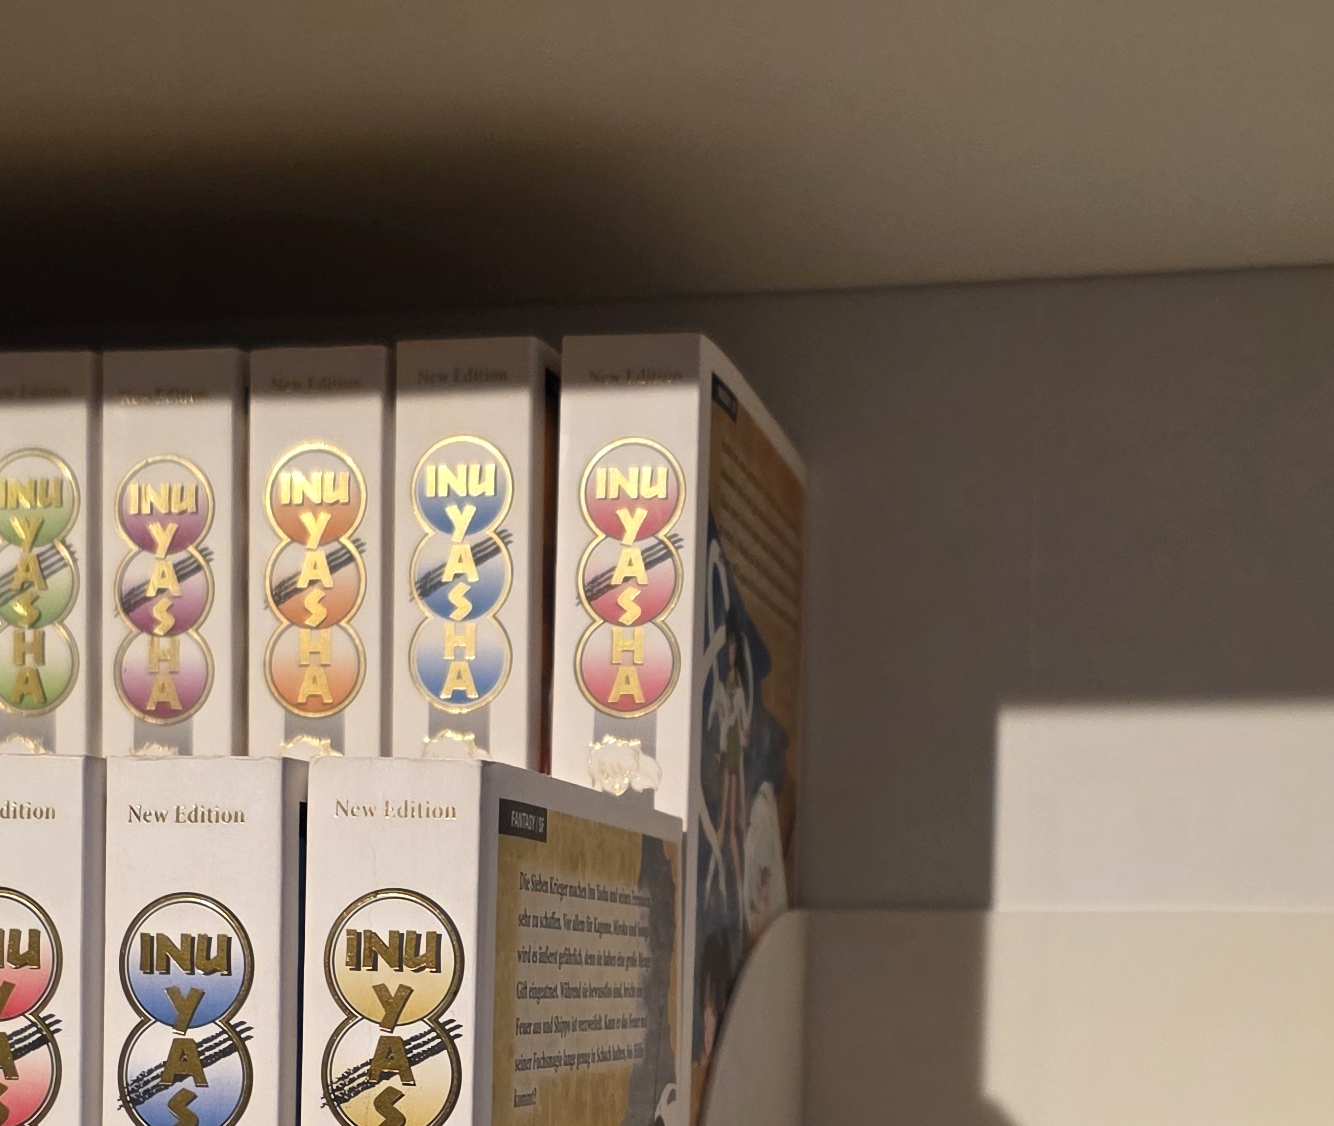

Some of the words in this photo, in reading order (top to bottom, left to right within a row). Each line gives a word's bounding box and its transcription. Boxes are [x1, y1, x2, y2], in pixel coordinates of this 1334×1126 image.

[279, 471, 350, 505] INU
[425, 463, 496, 497] INU
[595, 466, 668, 499] INU
[129, 482, 198, 515] INU
[128, 805, 168, 823] New
[175, 804, 245, 823] Edition
[336, 800, 376, 817] New
[385, 800, 456, 818] Edition
[140, 932, 232, 977] INU
[345, 928, 442, 973] INU
